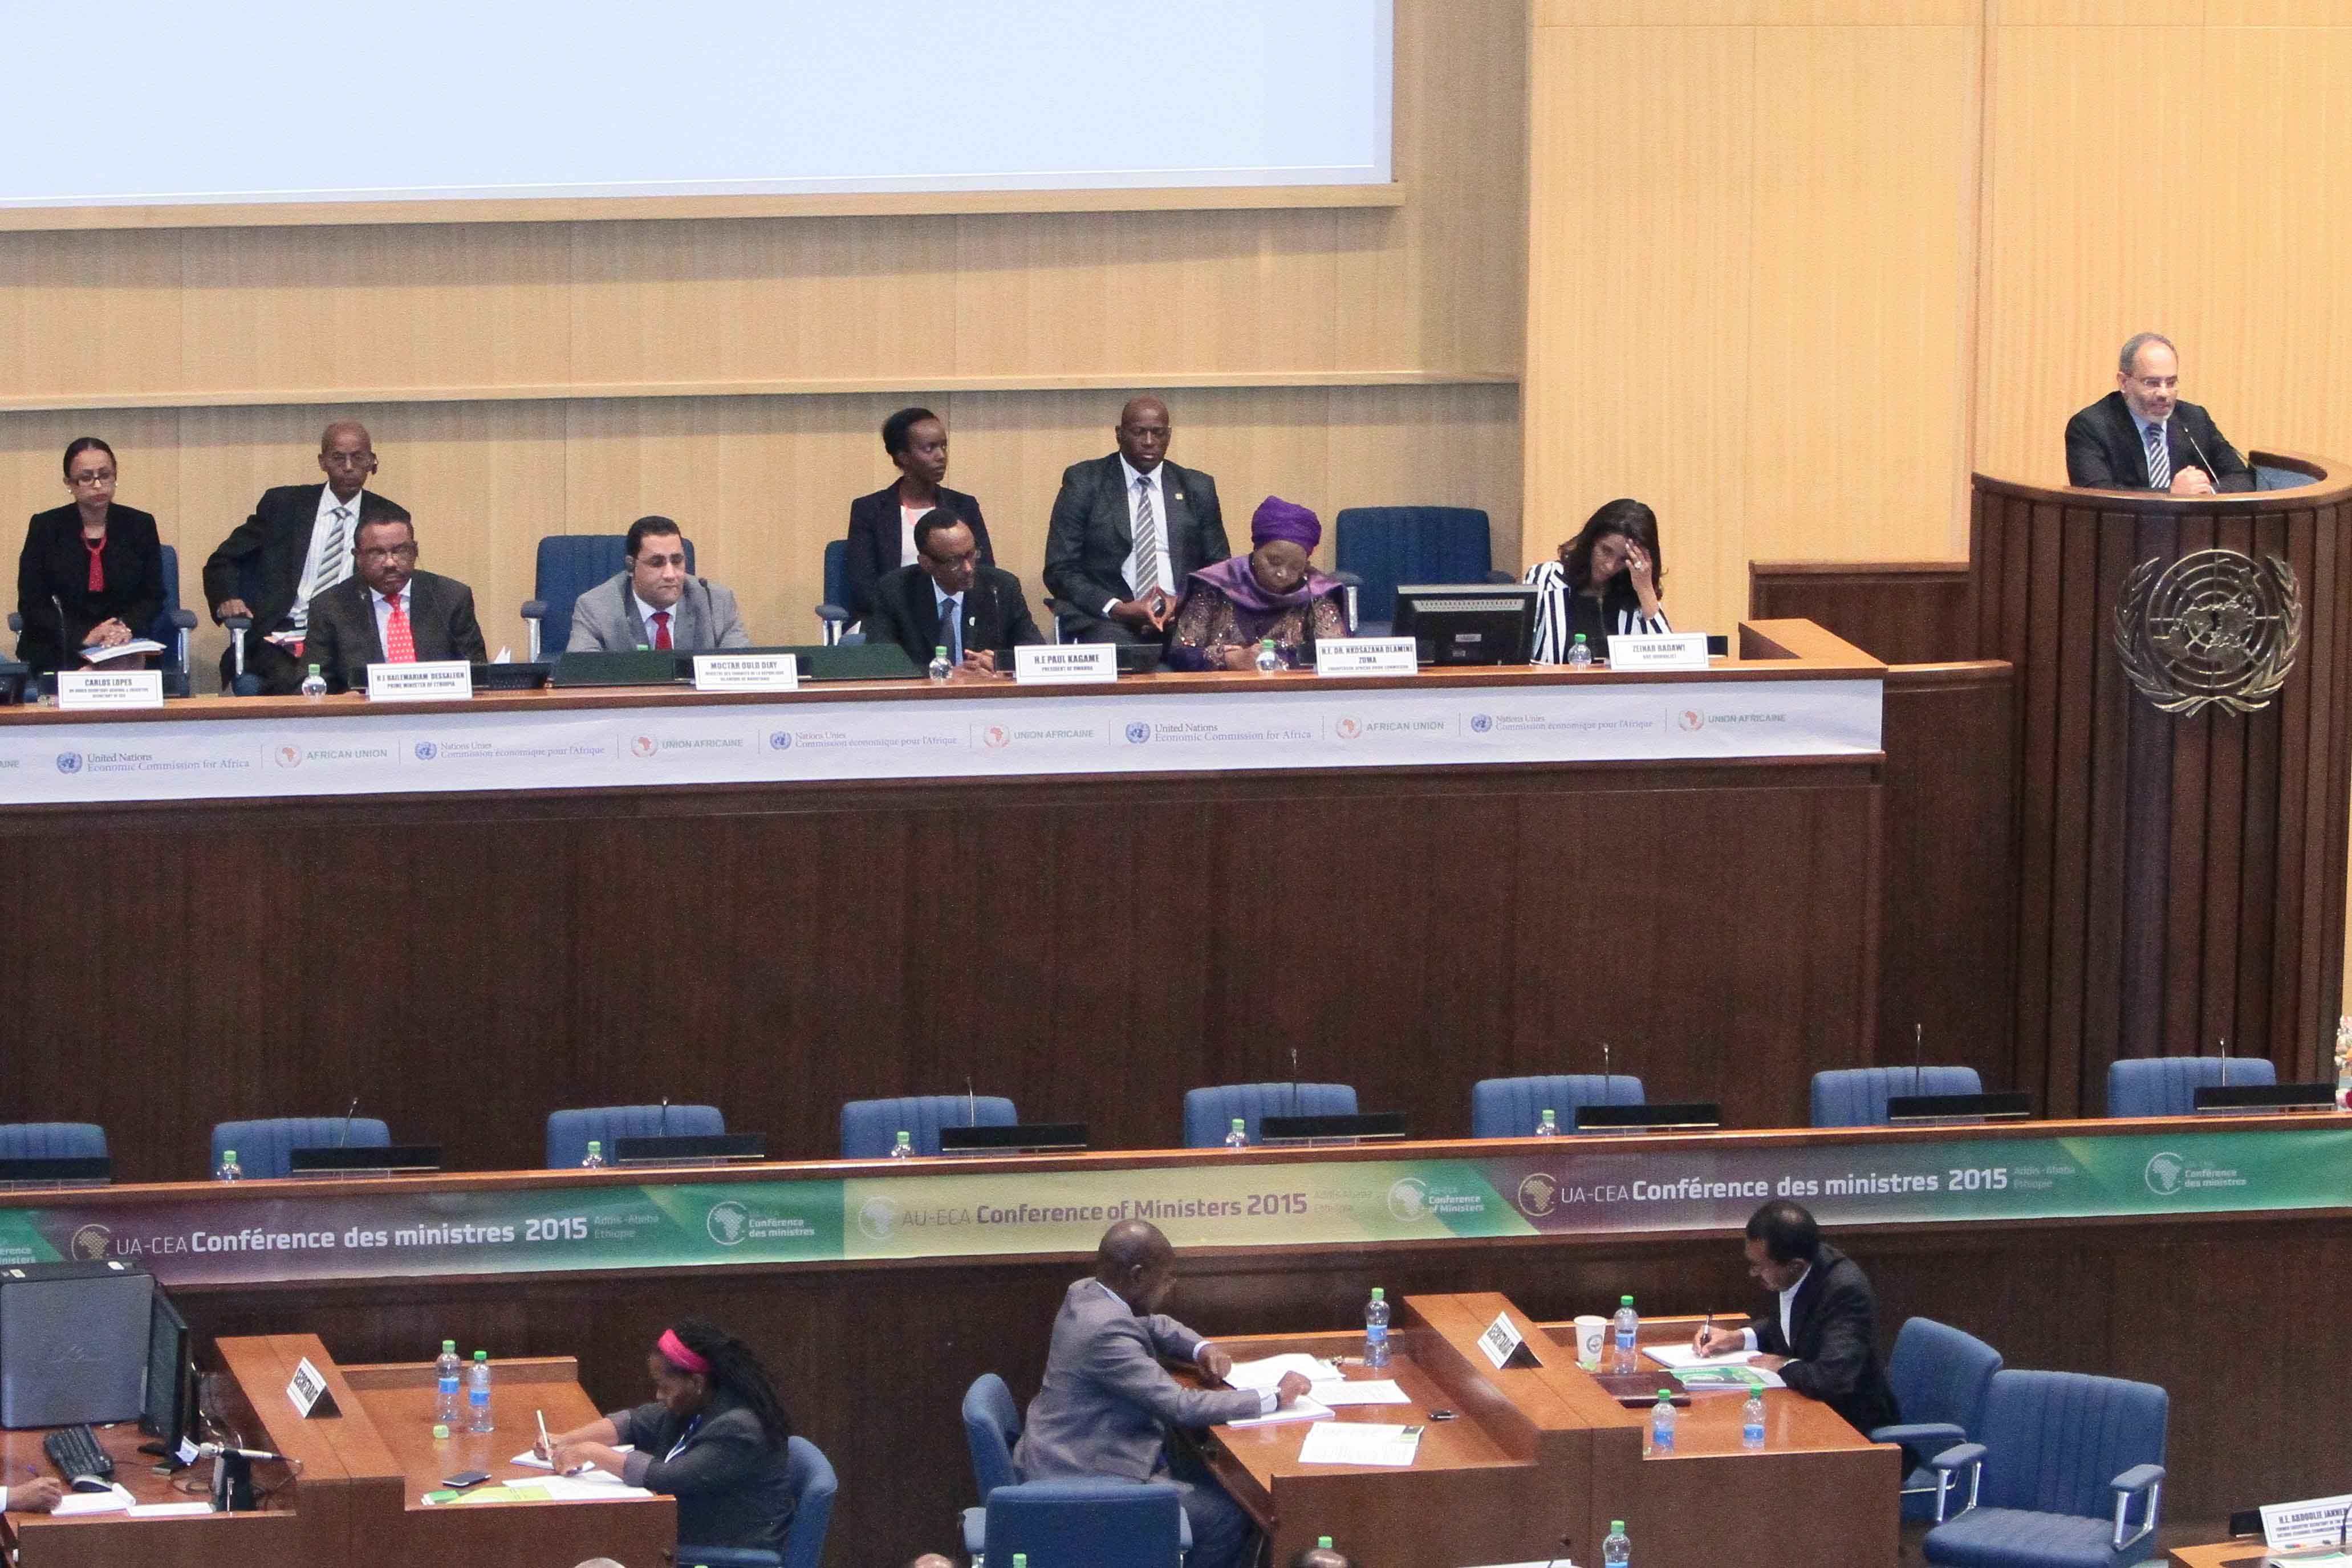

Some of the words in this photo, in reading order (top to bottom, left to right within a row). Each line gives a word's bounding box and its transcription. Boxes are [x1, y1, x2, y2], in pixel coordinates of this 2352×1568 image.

[1047, 655, 1066, 664] PAUL
[1068, 654, 1099, 663] KAGAME
[1709, 714, 1736, 723] UNION
[1738, 714, 1785, 722] AFRICAINE
[1155, 723, 1183, 733] United
[1185, 723, 1218, 732] Nations
[1366, 722, 1409, 731] AFRICAN
[1413, 721, 1444, 730] UNION
[1496, 722, 1546, 731] Commission
[1548, 721, 1596, 730] économique
[1619, 720, 1653, 729] l'Afrique
[1014, 731, 1043, 740] UNION
[1045, 729, 1094, 738] AFRICAINE
[1155, 733, 1201, 742] Economic
[1204, 732, 1264, 741] Commission
[1266, 730, 1279, 740] for
[1282, 730, 1311, 740] Africa
[694, 739, 742, 748] AFRICAINE
[795, 740, 847, 748] Commission
[848, 738, 898, 748] économique
[900, 738, 920, 747] pour
[923, 736, 957, 746] l'Afrique
[87, 754, 117, 763] United
[119, 752, 152, 762] Nations
[306, 750, 352, 760] AFRICAN
[355, 749, 387, 758] UNION
[495, 748, 546, 758] économique
[547, 749, 566, 757] pour
[570, 746, 604, 757] l'Afrique
[87, 762, 136, 771] Economic
[139, 761, 200, 770] Commission
[203, 760, 216, 769] for
[220, 759, 250, 768] Africa
[2185, 1169, 2237, 1177] Conférence
[1561, 1186, 1628, 1204] UA-CEA
[1633, 1176, 1768, 1201] Conférence
[1777, 1176, 1819, 1197] des
[1825, 1173, 1939, 1195] ministres
[1948, 1168, 2008, 1191] 2015
[902, 1209, 970, 1227] AU-ECA
[977, 1204, 1103, 1225] Conference
[1108, 1200, 1131, 1220] of
[1134, 1198, 1242, 1220] Ministers
[1247, 1193, 1308, 1216] 2015
[1440, 1204, 1484, 1213] Ministers
[749, 1218, 803, 1228] Conférence
[117, 1237, 187, 1255] UA-CEA
[192, 1228, 335, 1253] Conférence
[344, 1226, 388, 1248] des
[395, 1224, 514, 1246] ministres
[525, 1217, 588, 1241] 2015
[768, 1228, 815, 1237] ministres
[2292, 1511, 2322, 1522] ABDOULIE
